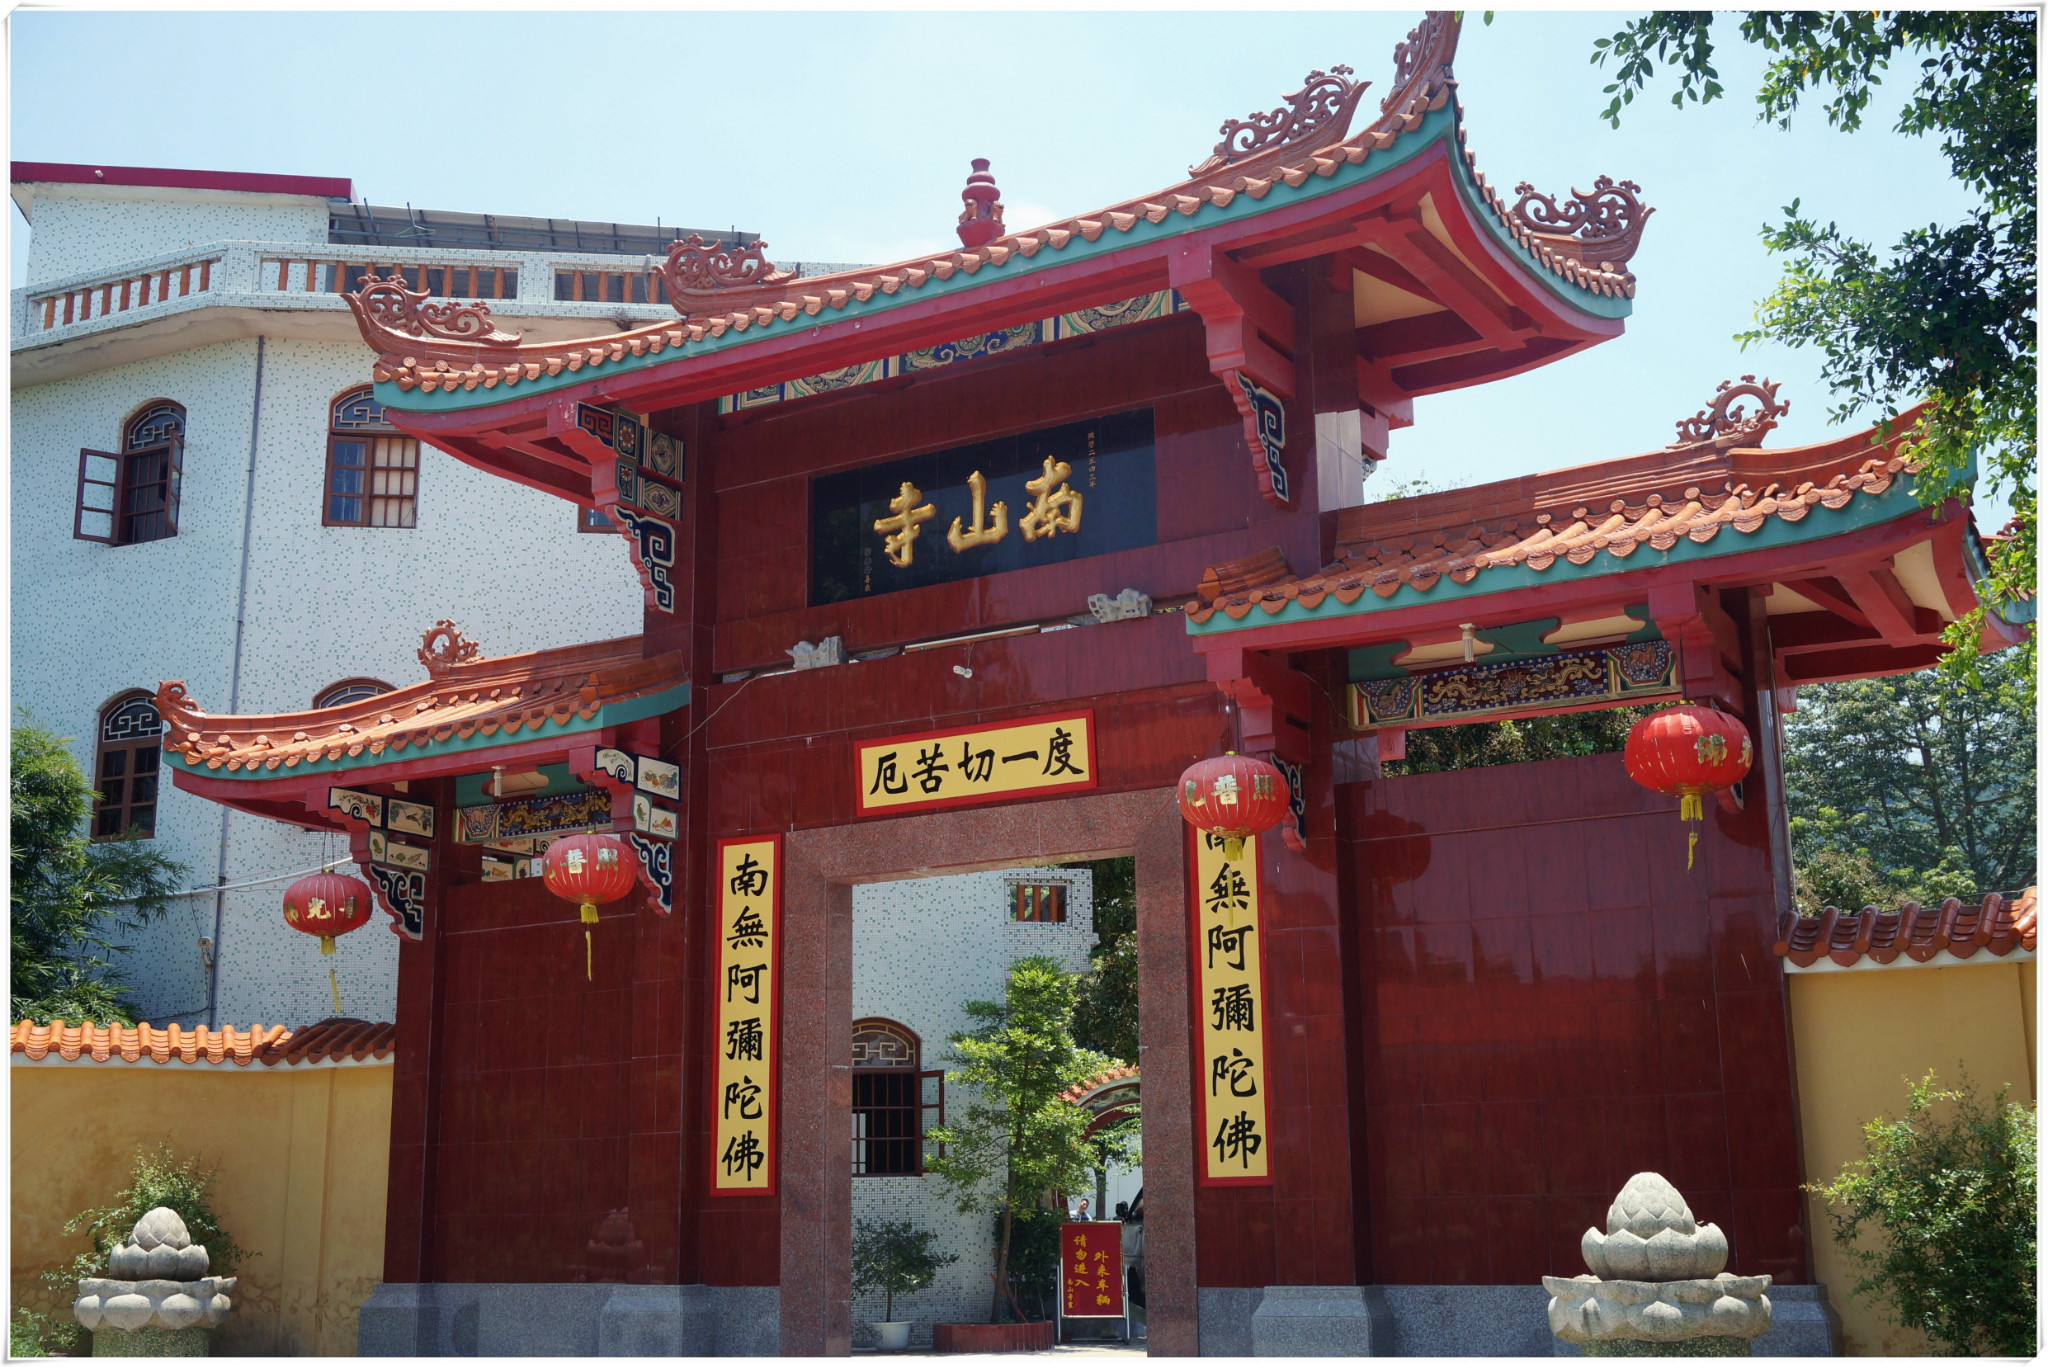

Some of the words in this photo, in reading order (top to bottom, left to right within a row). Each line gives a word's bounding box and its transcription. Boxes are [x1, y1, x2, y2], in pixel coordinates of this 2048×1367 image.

[874, 454, 1083, 568] 南山寺
[870, 727, 1084, 795] 度一切苦厄
[721, 853, 769, 1181] 南無阿彌陀佛
